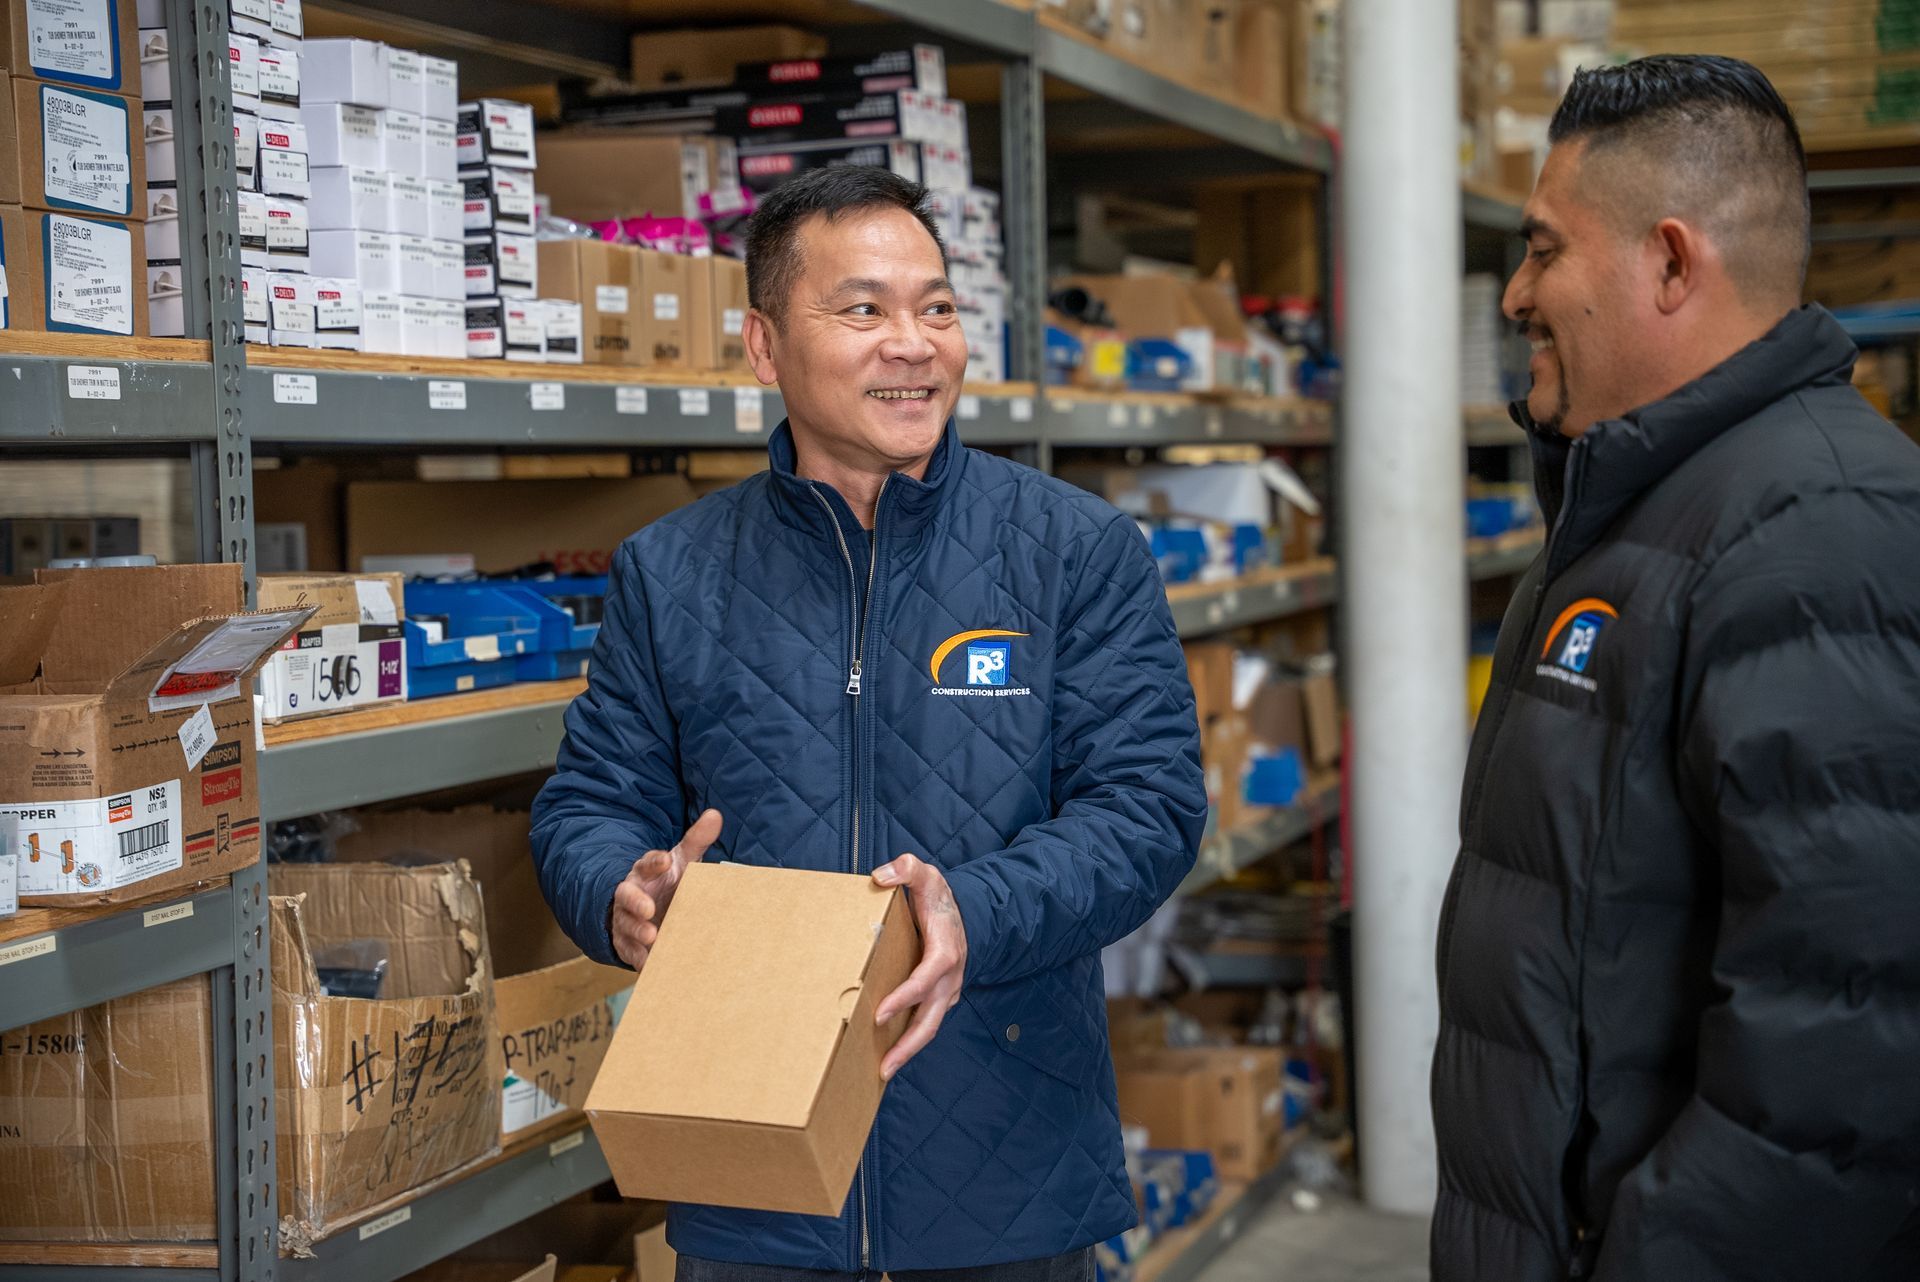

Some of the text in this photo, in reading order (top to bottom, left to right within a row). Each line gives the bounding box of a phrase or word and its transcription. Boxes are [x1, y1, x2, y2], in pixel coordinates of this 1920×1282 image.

[230, 50, 240, 59] LTA
[271, 135, 289, 145] DELTA
[279, 288, 295, 298] DELTA
[301, 636, 321, 648] ADAPTER
[932, 688, 1030, 696] CONSTRUCTION SERVICES
[204, 746, 239, 766] SIMPSON
[149, 787, 165, 802] NS2
[110, 798, 131, 808] SIMPSON
[128, 856, 134, 864] 00
[22, 947, 34, 955] STOP
[0, 1126, 21, 1138] INA
